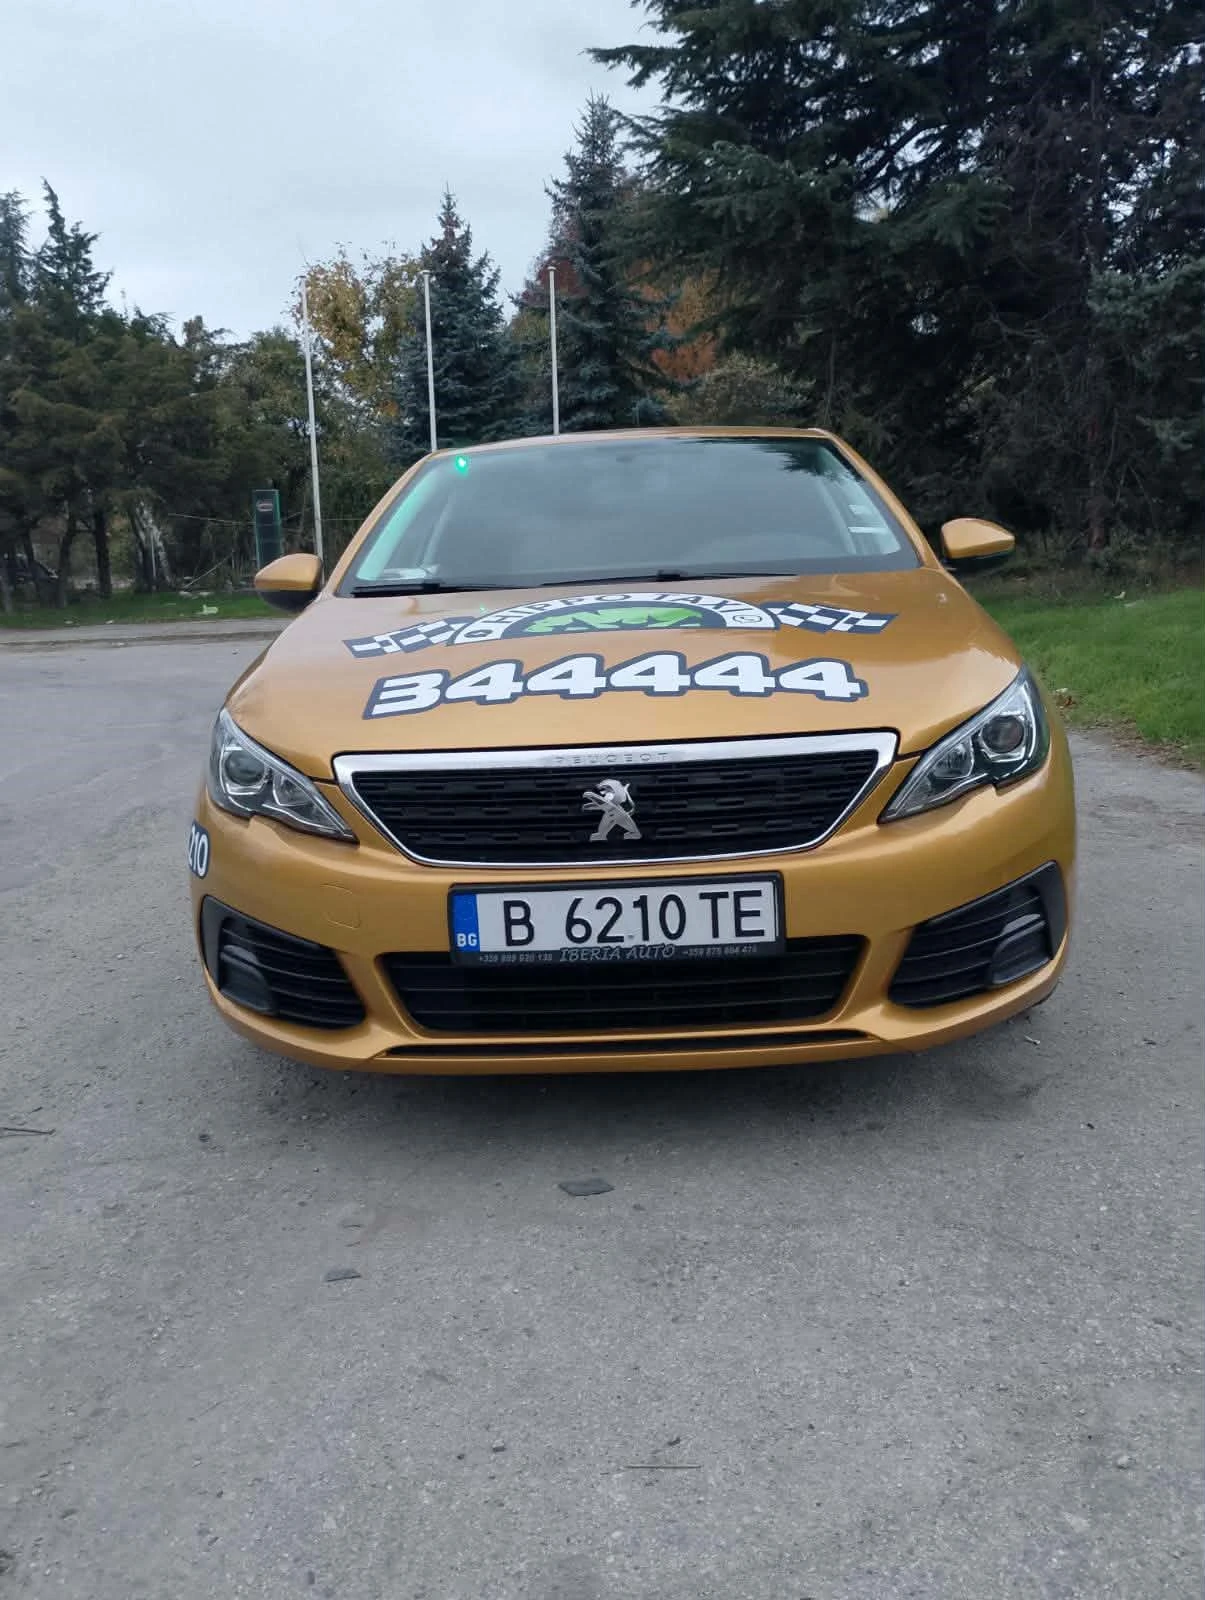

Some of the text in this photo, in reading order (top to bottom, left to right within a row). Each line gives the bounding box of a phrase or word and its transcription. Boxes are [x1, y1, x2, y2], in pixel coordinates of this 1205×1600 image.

[482, 593, 753, 624] HIPPO TAXI
[367, 652, 864, 717] 344444
[553, 752, 668, 764] PEUGEOT
[502, 889, 765, 946] B 6210 TE
[456, 932, 477, 947] BG
[559, 947, 621, 962] IBERIA
[626, 943, 676, 960] AUTO
